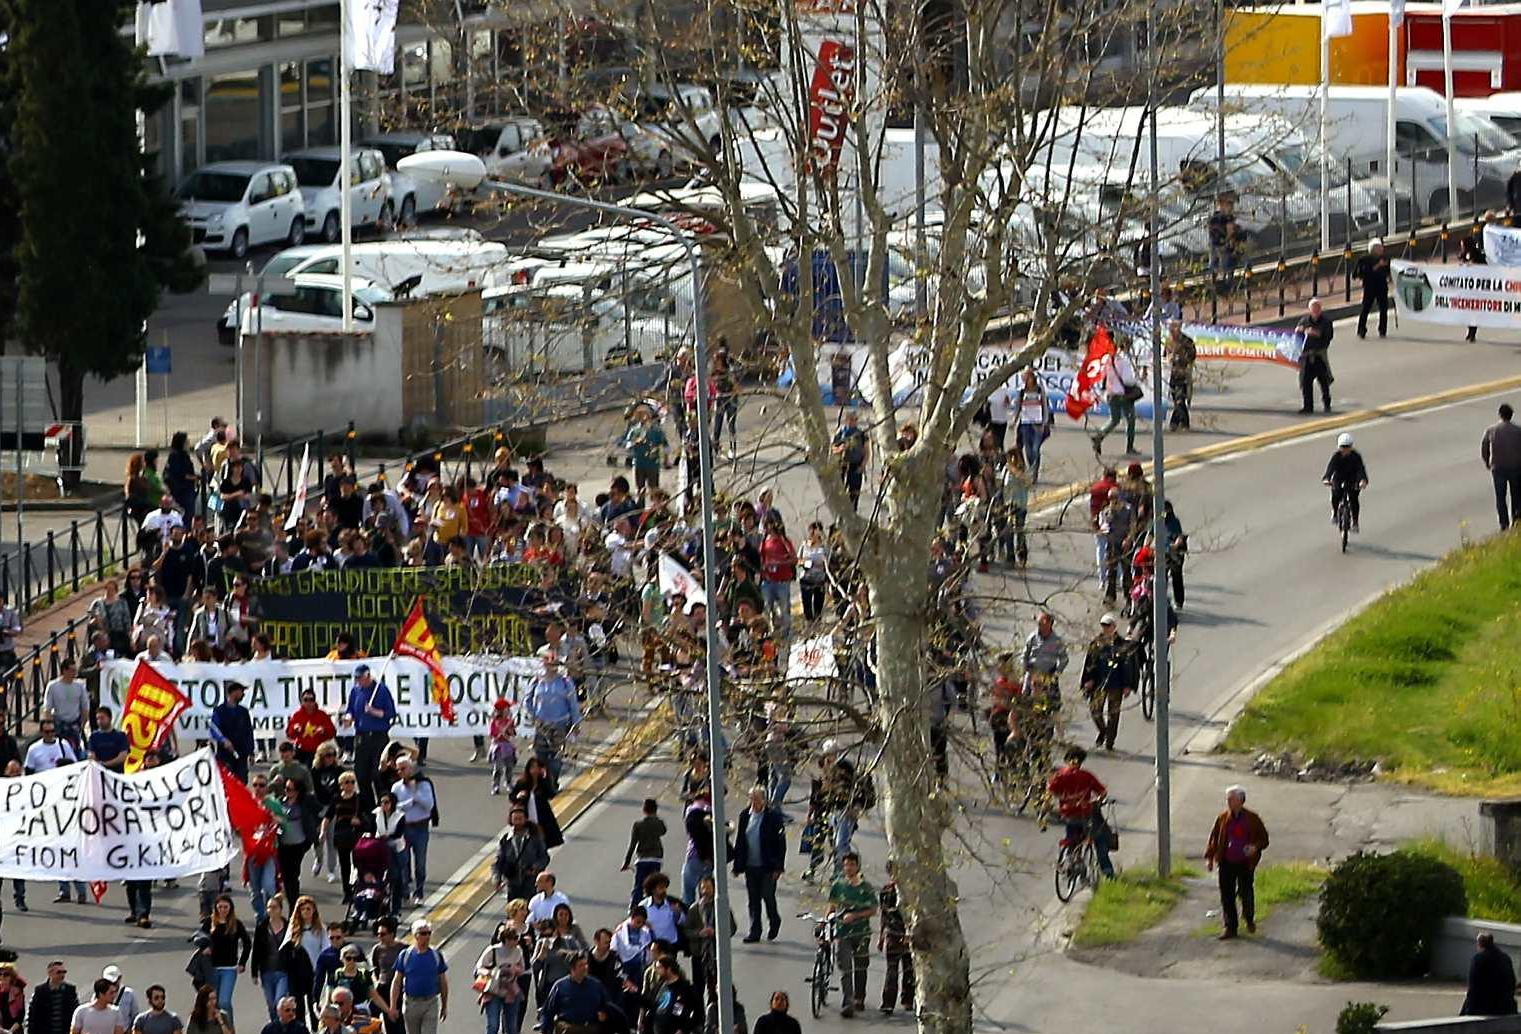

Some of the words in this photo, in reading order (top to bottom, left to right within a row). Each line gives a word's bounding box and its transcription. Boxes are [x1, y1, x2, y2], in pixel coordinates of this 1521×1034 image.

[1439, 275, 1475, 290] COMITATO
[1476, 279, 1491, 291] PER
[1493, 280, 1503, 292] LA
[100, 758, 212, 804] NEMICO
[15, 845, 79, 869] FIOM
